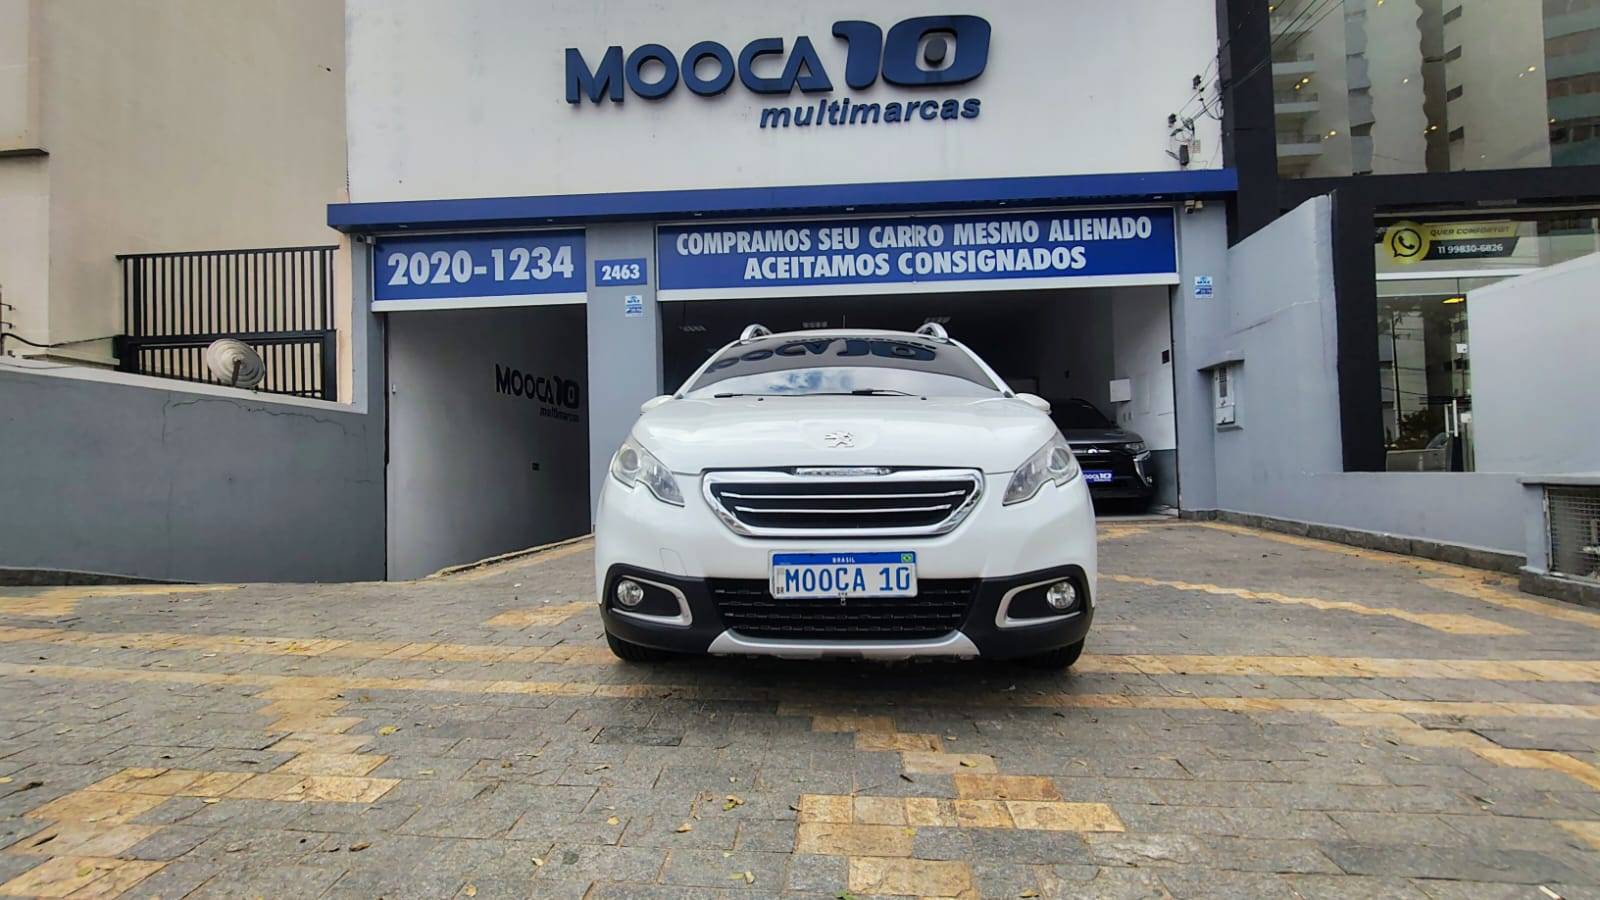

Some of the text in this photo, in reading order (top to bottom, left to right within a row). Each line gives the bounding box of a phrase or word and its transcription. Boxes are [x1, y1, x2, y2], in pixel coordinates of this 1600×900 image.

[565, 15, 992, 105] MOOCA 10
[760, 98, 982, 128] multimarcas
[676, 216, 1152, 256] COMPRAMOS SEU CARRO MESMO ALIENADO
[387, 246, 574, 286] 2020-1234
[601, 264, 641, 281] 2463
[744, 246, 1087, 280] ACEITAMOS CONSIGNADOS
[495, 363, 580, 409] MOOCA 10
[831, 556, 856, 564] BRASIL
[785, 567, 911, 593] MOOCA 10
